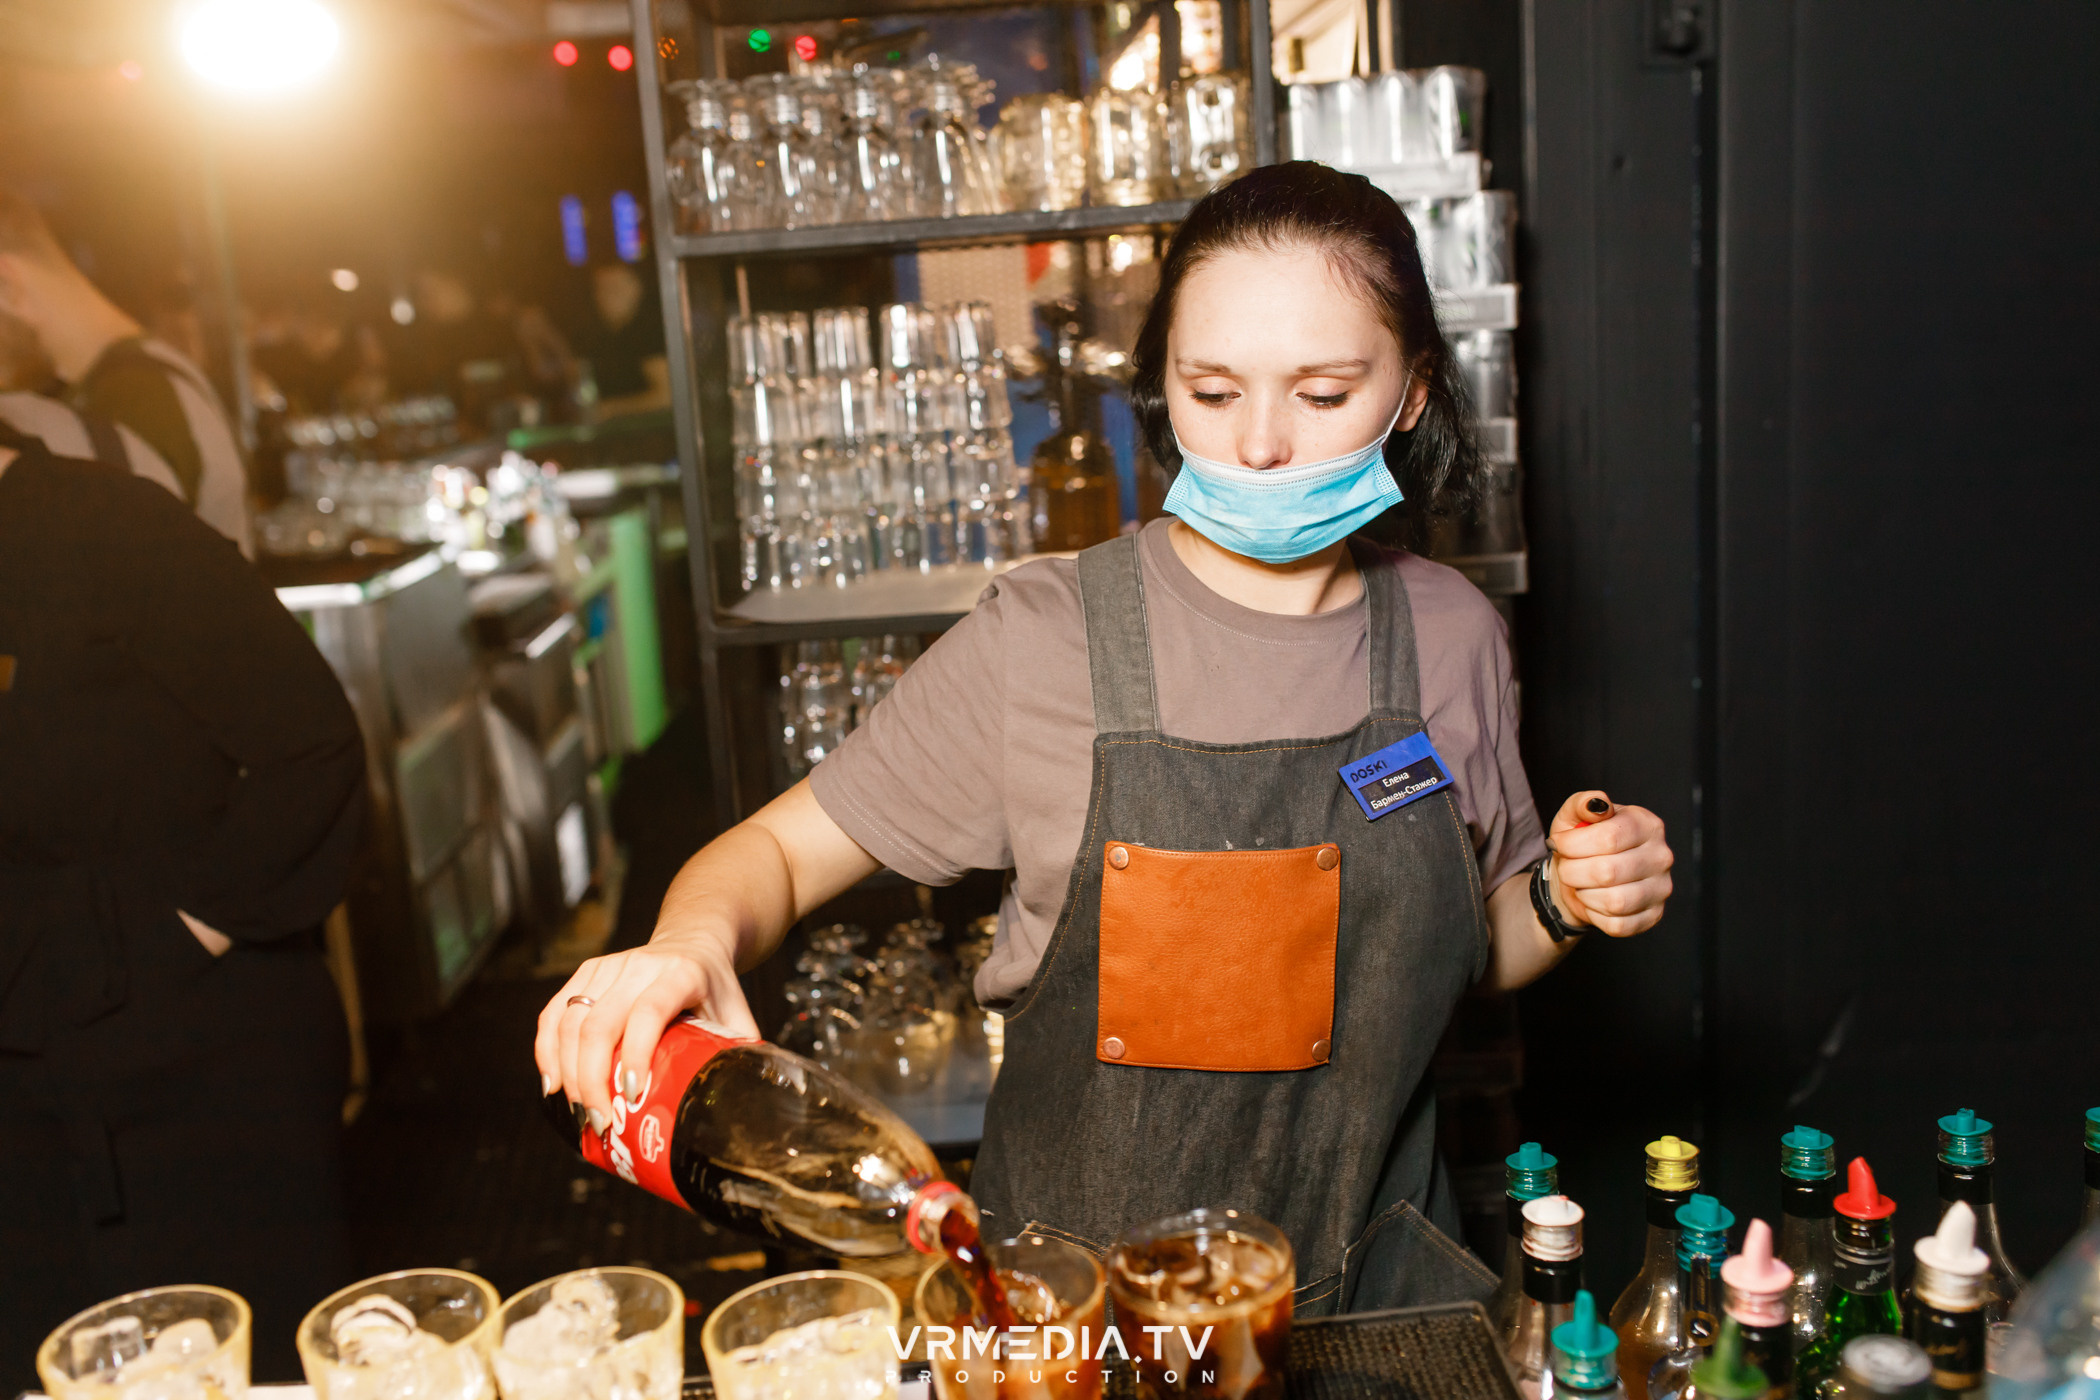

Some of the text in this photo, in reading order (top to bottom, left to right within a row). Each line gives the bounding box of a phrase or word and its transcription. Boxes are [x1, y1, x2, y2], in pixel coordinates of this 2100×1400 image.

[1350, 760, 1388, 783] DOSKI
[1382, 771, 1410, 788] Елена
[1370, 776, 1438, 810] Бармен-Стажер
